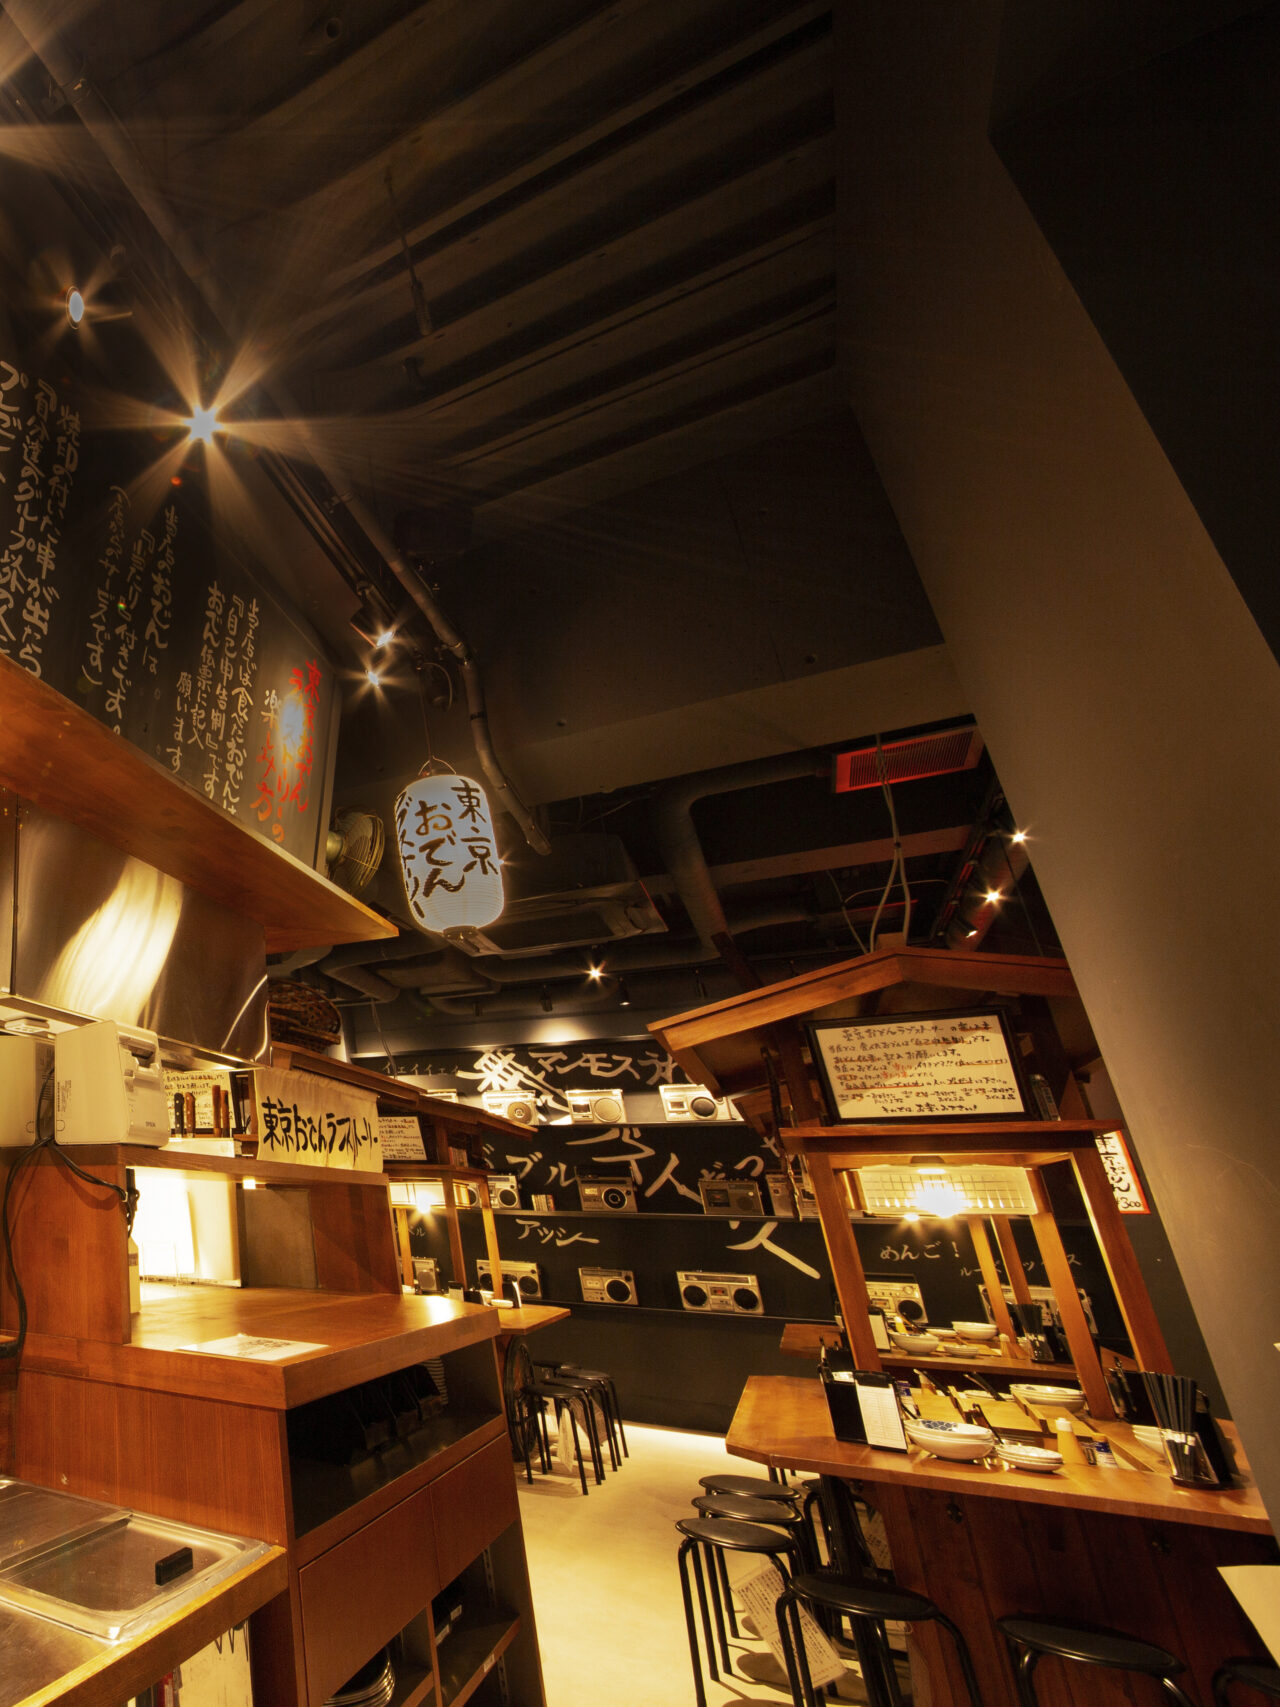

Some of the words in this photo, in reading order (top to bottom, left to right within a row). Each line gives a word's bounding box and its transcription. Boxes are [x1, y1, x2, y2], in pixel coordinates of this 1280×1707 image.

[414, 800, 466, 898] おでん
[451, 778, 499, 876] 東京
[514, 1218, 601, 1247] アッシー
